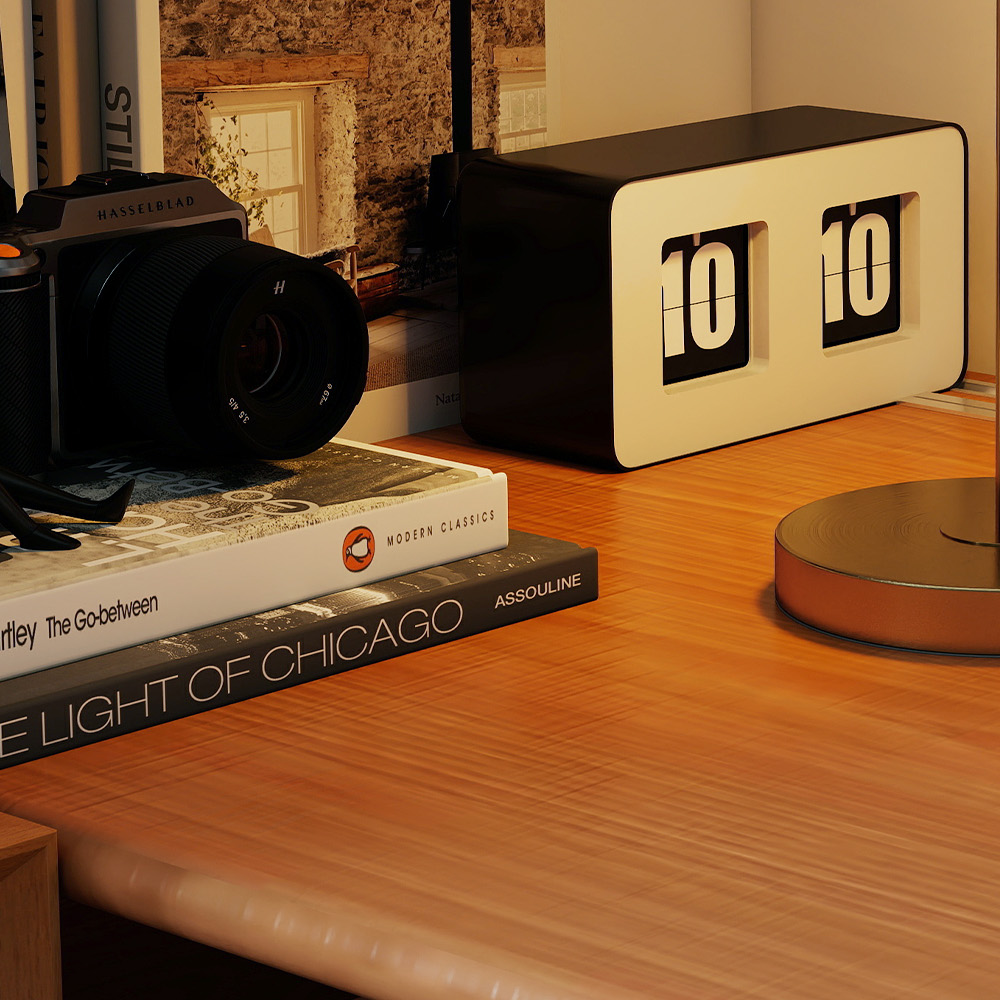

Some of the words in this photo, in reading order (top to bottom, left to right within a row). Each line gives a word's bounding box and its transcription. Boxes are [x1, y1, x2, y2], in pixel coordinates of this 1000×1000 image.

[96, 195, 195, 221] HASSELBLAD
[661, 241, 736, 358] 10
[822, 213, 891, 324] 10
[386, 525, 434, 547] MODERN
[440, 510, 496, 534] CLASSICS
[45, 615, 71, 639] The
[73, 595, 159, 631] Go-between
[41, 674, 179, 746] LIGHT
[188, 655, 251, 702] OF
[262, 599, 464, 682] CHICAGO
[494, 573, 582, 610] ASSOULINE
